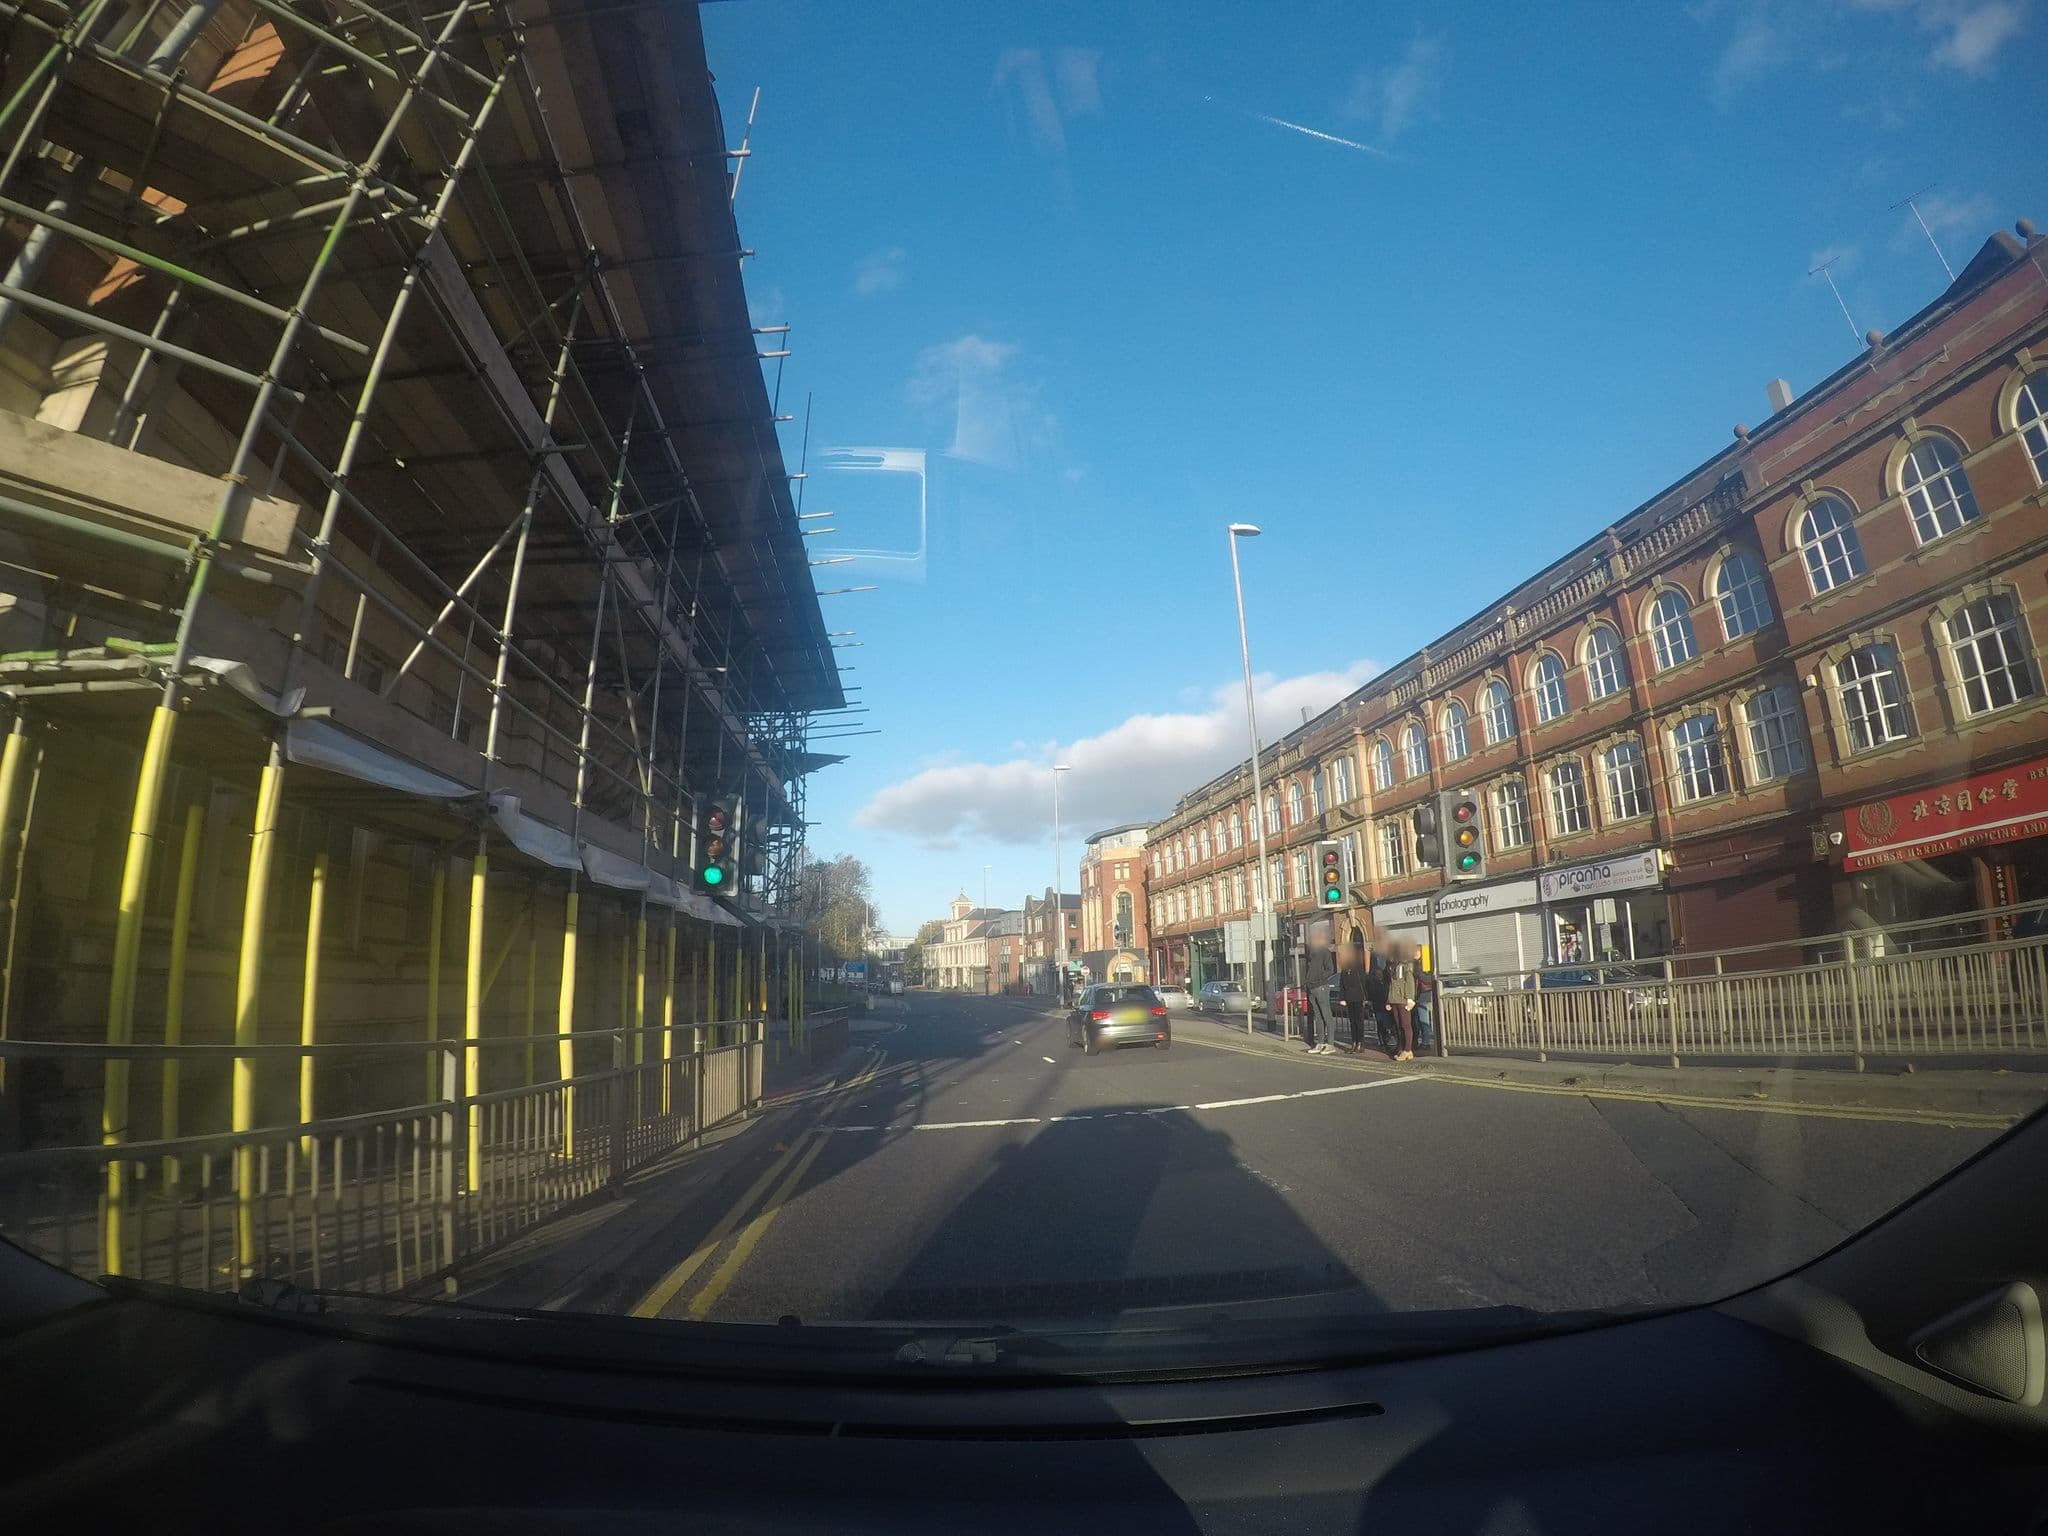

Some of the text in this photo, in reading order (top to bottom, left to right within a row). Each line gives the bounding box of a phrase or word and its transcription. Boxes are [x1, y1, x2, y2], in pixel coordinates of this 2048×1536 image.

[1912, 779, 2018, 821] 北京同仁堂
[1856, 820, 2047, 868] CHINESE HERBAL MEDICINE AND
[1558, 865, 1611, 889] piranha
[1441, 894, 1490, 914] photography
